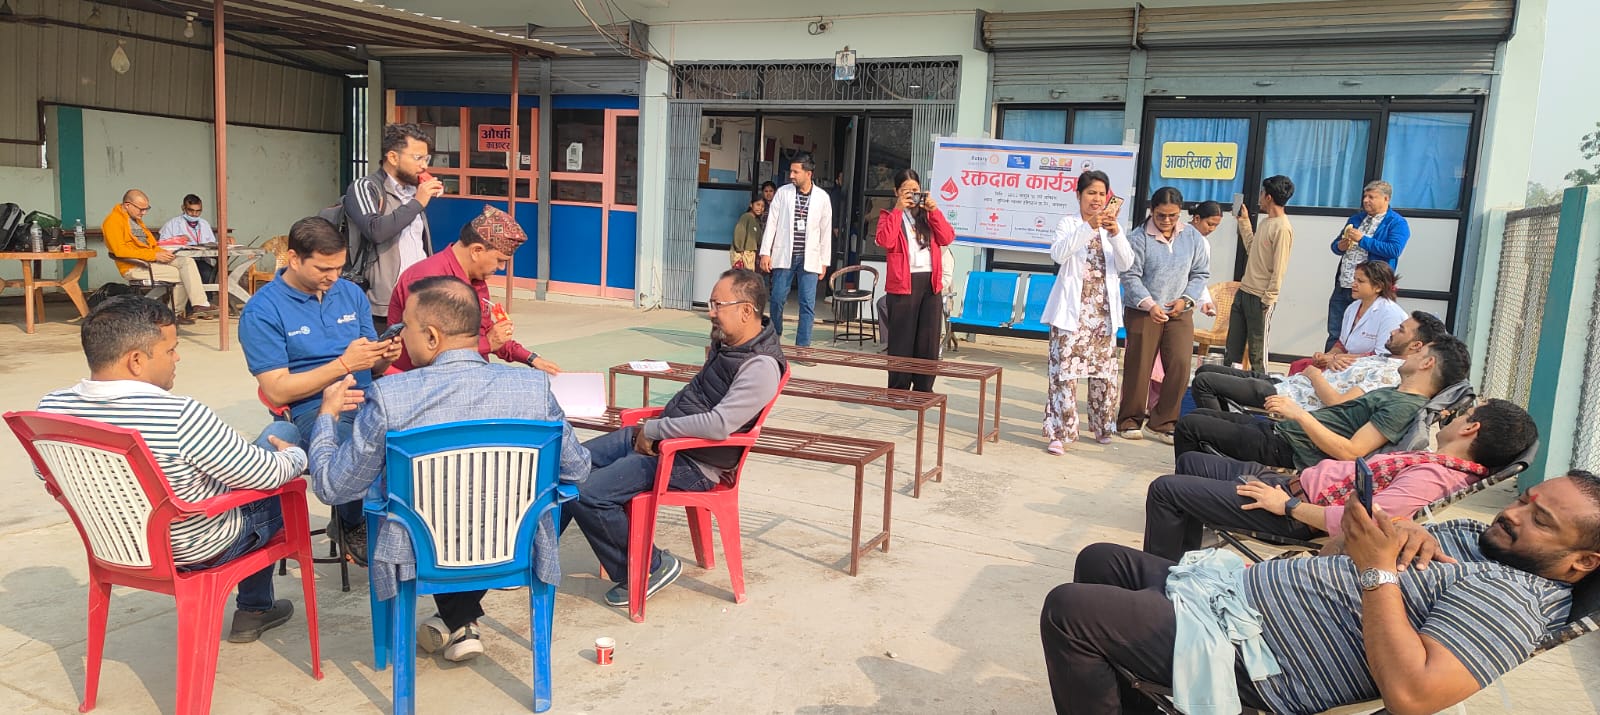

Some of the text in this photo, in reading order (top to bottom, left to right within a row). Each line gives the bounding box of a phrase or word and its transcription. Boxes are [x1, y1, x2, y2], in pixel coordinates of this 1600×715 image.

[1165, 150, 1233, 170] आकस्मिक सेवा
[961, 170, 1021, 189] रक्तदान
